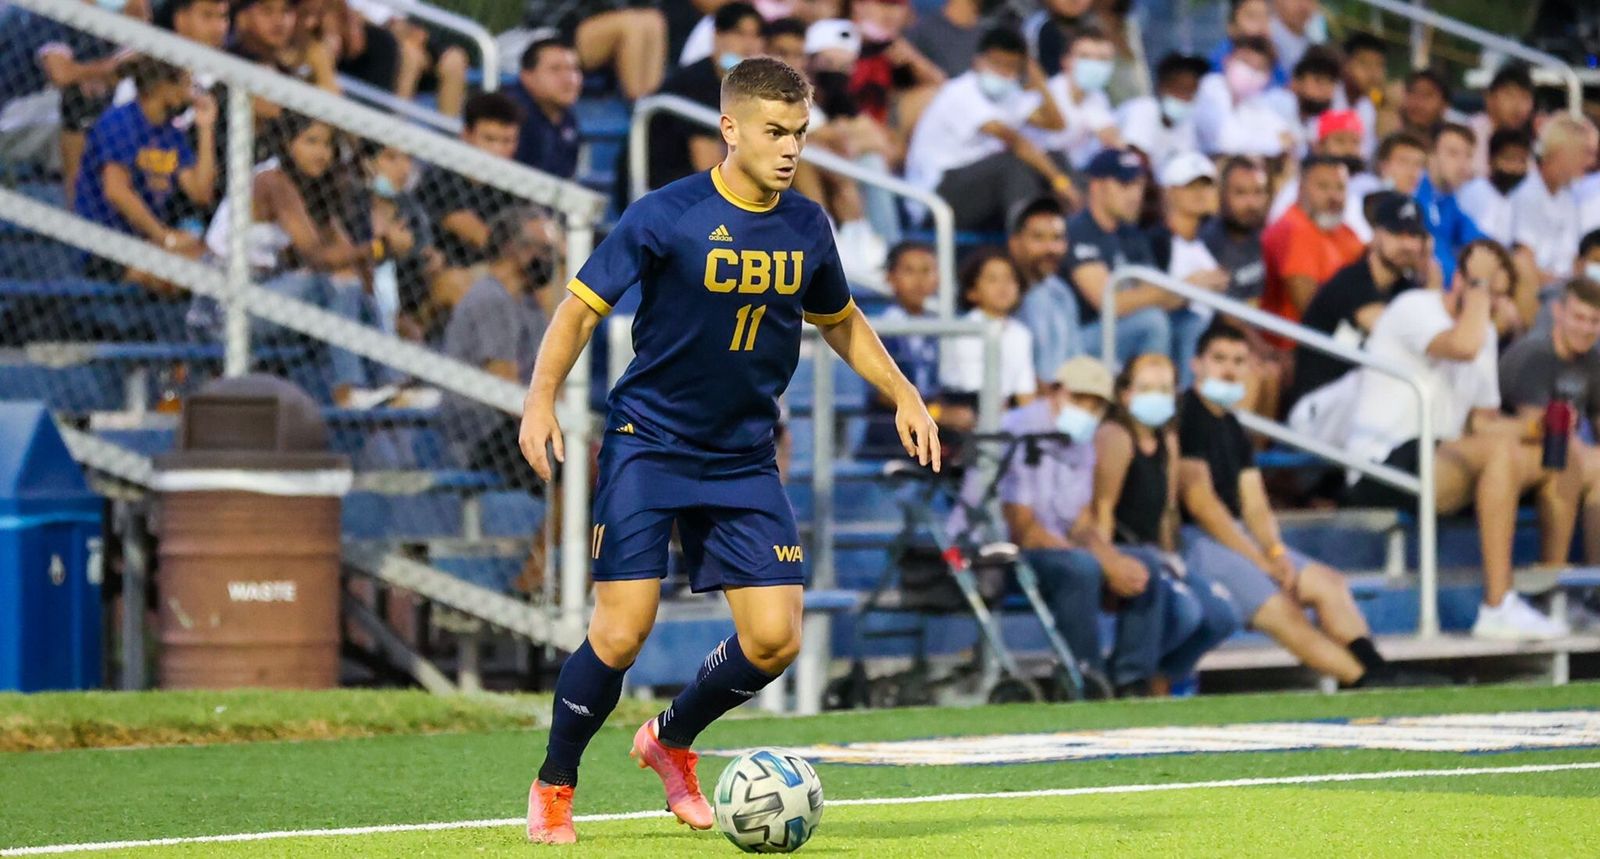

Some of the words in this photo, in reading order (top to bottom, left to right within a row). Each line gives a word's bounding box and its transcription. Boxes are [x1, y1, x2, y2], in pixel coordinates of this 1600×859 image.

[708, 234, 733, 242] adidas
[704, 249, 803, 295] CBU
[729, 304, 767, 351] 11
[592, 523, 606, 559] 11
[227, 580, 297, 602] WASTE
